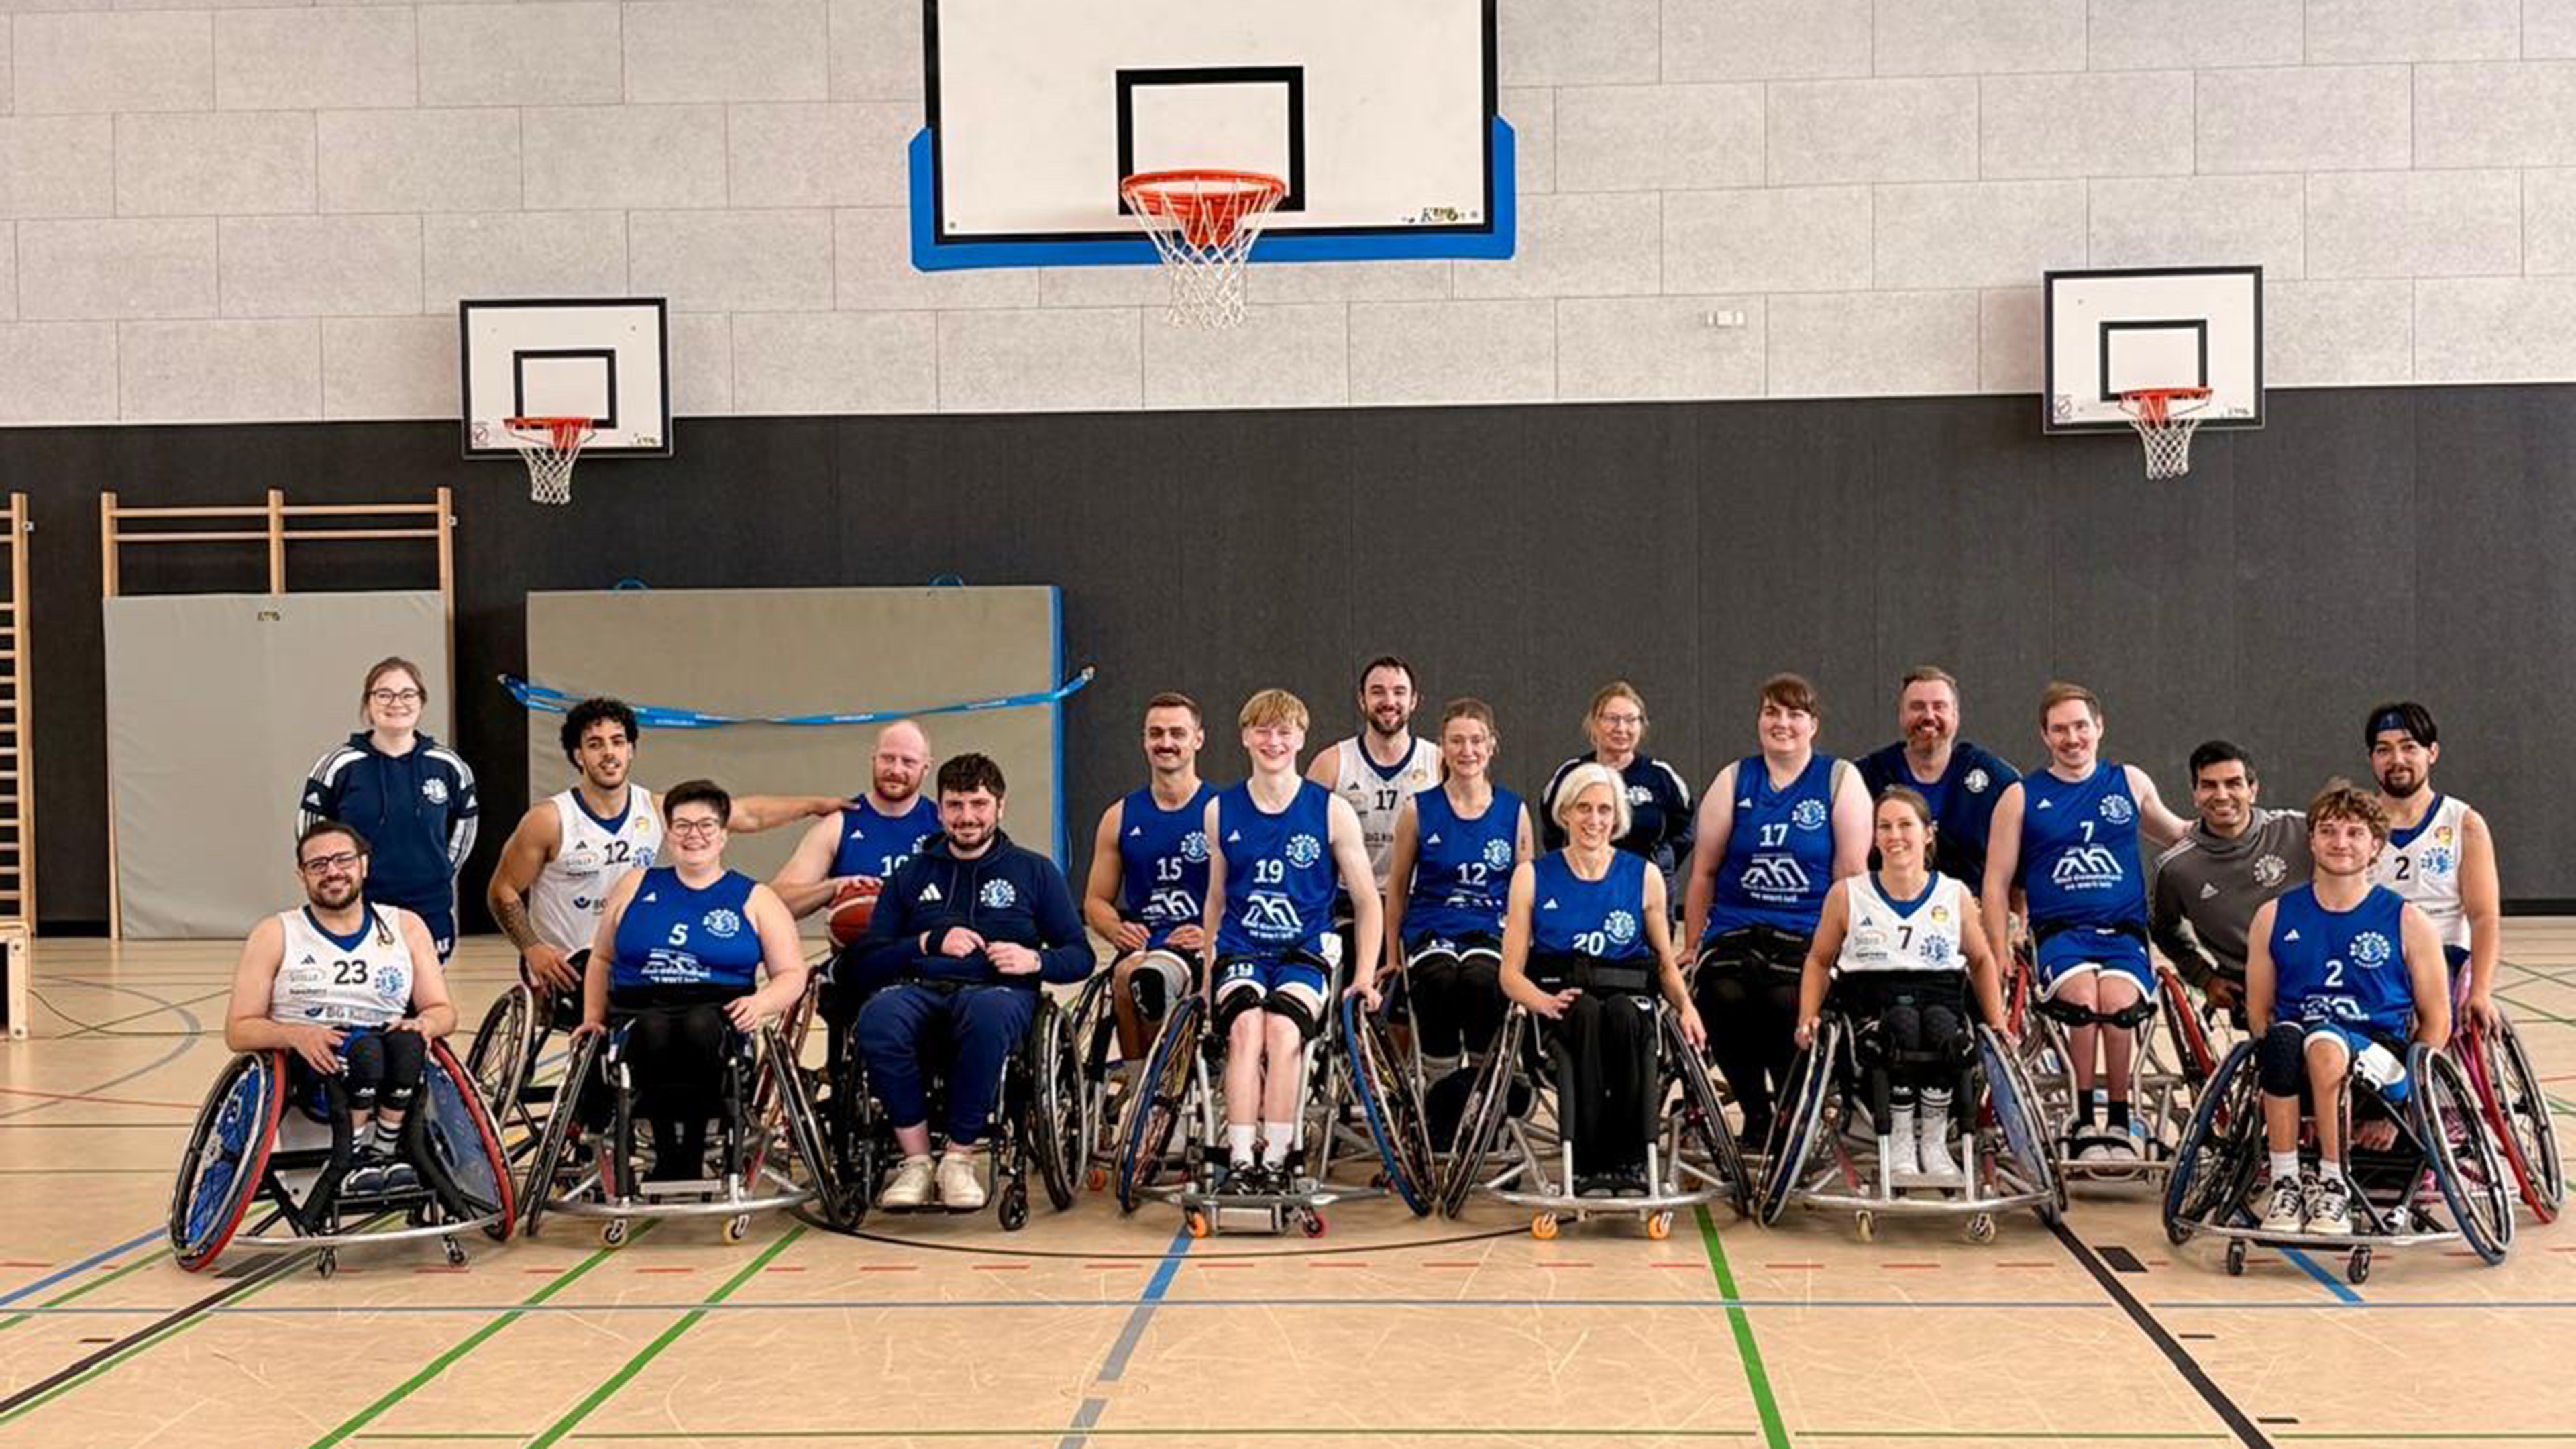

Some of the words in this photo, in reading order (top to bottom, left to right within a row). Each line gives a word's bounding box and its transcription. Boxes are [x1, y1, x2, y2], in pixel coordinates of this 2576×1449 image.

[1375, 789, 1398, 810] 17
[1759, 824, 1788, 847] 17
[2080, 821, 2094, 843] 7
[604, 840, 631, 866] 12
[1157, 857, 1182, 881] 15
[1253, 859, 1284, 883] 19
[1457, 863, 1487, 886] 12
[2395, 856, 2410, 880] 2
[669, 923, 688, 945] 5
[1573, 931, 1605, 956] 20
[1898, 926, 1913, 949] 7
[333, 959, 368, 985] 23
[2324, 959, 2343, 987] 2
